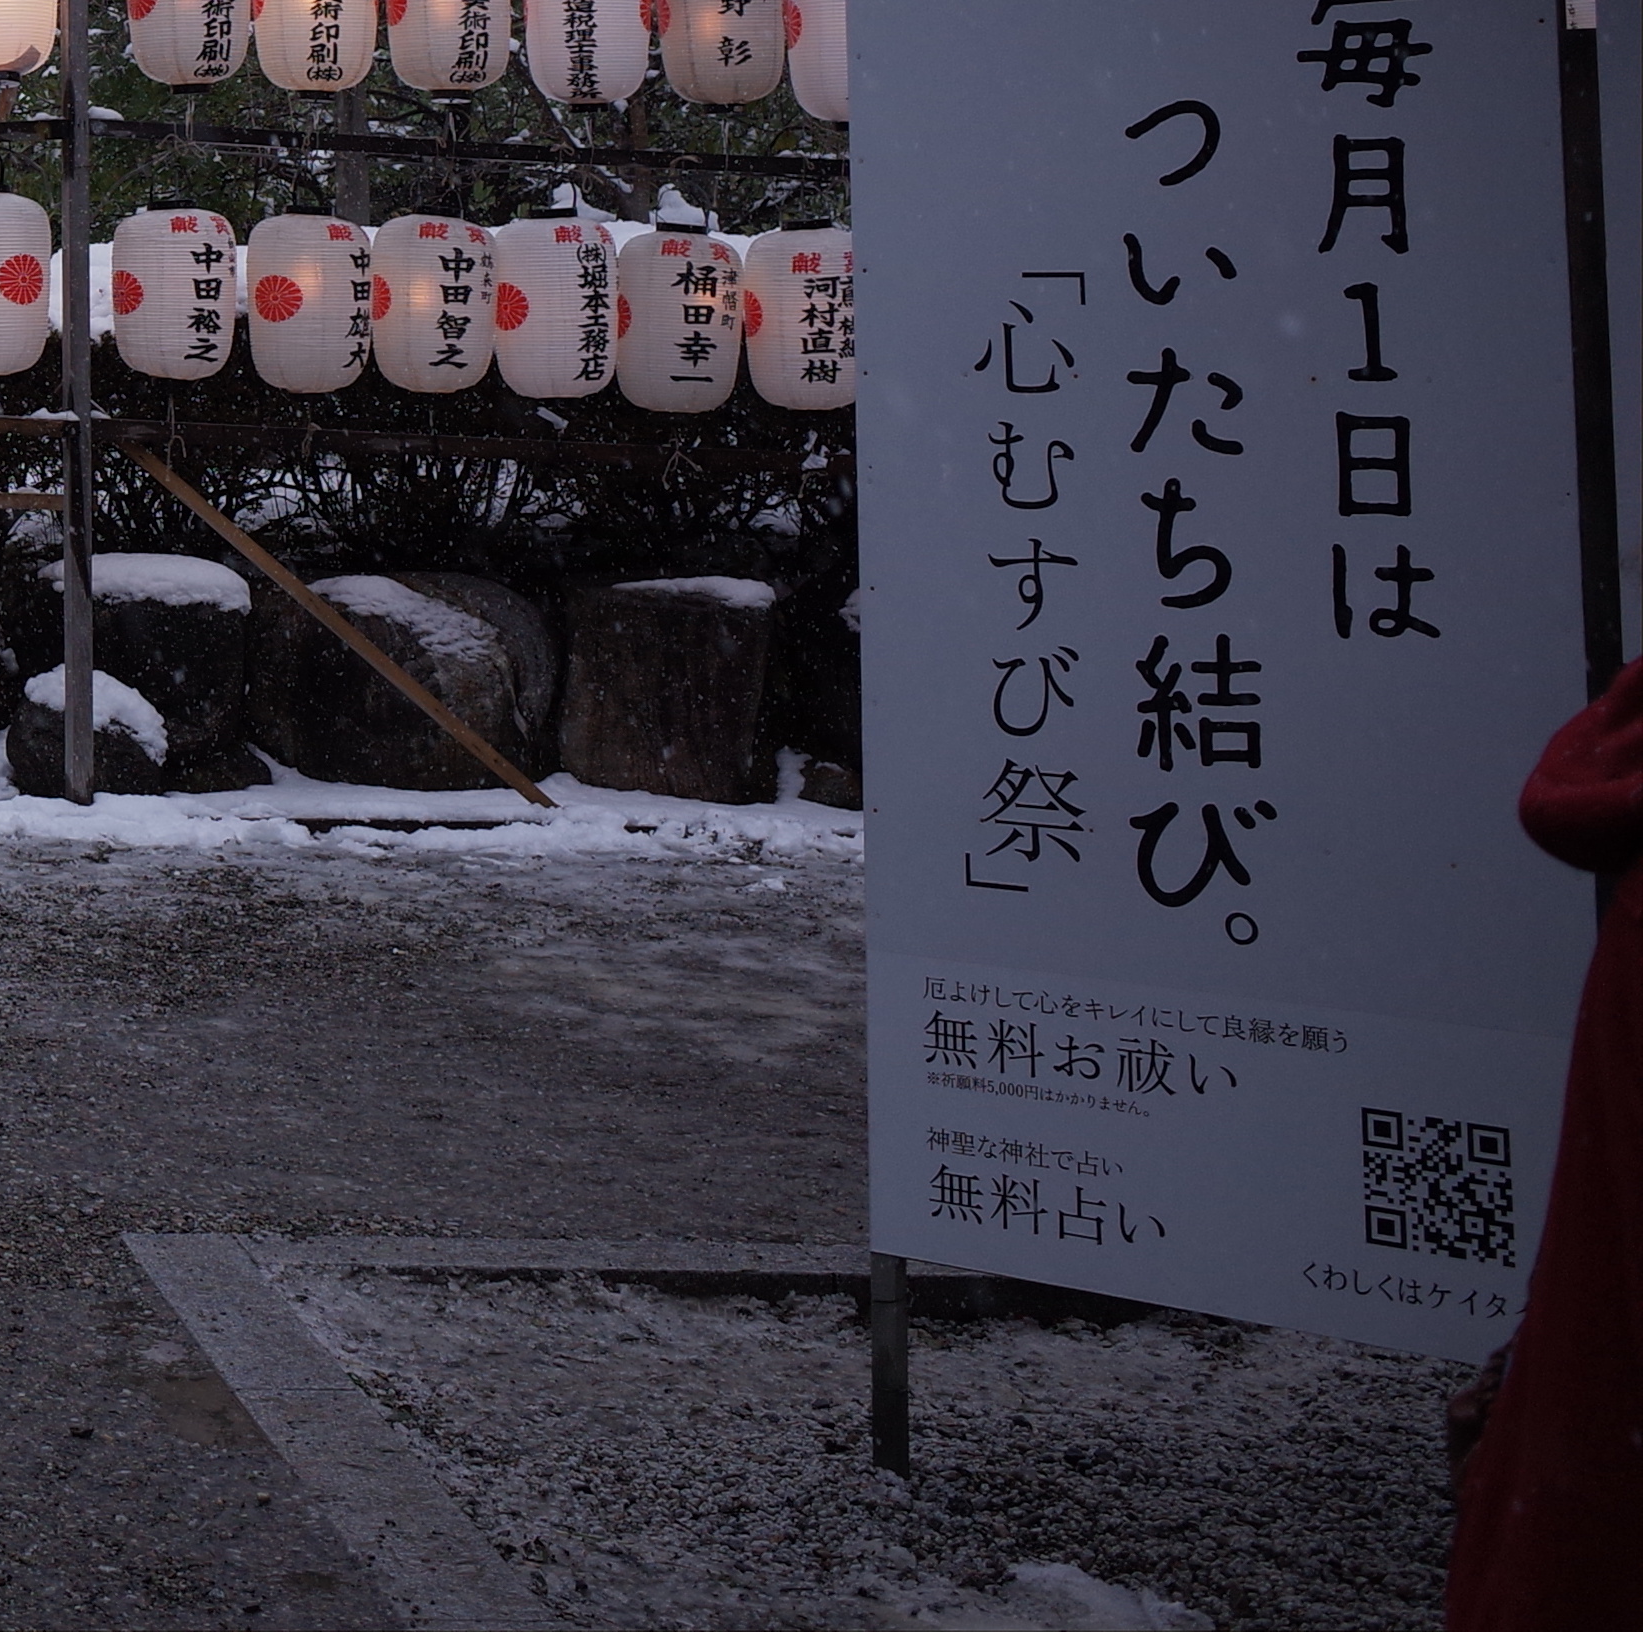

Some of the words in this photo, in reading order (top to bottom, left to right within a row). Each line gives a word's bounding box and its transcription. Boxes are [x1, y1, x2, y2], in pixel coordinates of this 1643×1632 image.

[183, 243, 224, 364] 中田裕之
[429, 247, 477, 369] 中田智之
[574, 242, 611, 382] (株)堀本工務店
[670, 260, 718, 384] 桶田幸一
[720, 268, 740, 332] 津幡町
[798, 275, 842, 385] 河村直樹
[1125, 100, 1278, 946] ついたち結び。
[966, 271, 1086, 894] 「心むすび祭」
[922, 976, 1350, 1055] 厄よけして心をキレイにして良縁を願う
[923, 1011, 1240, 1097] 無料お祓い
[926, 1071, 1152, 1120] ※祈願料5,000円はかかりません。
[926, 1129, 1125, 1178] 神聖な神社で占い
[929, 1164, 1167, 1246] 無料占い
